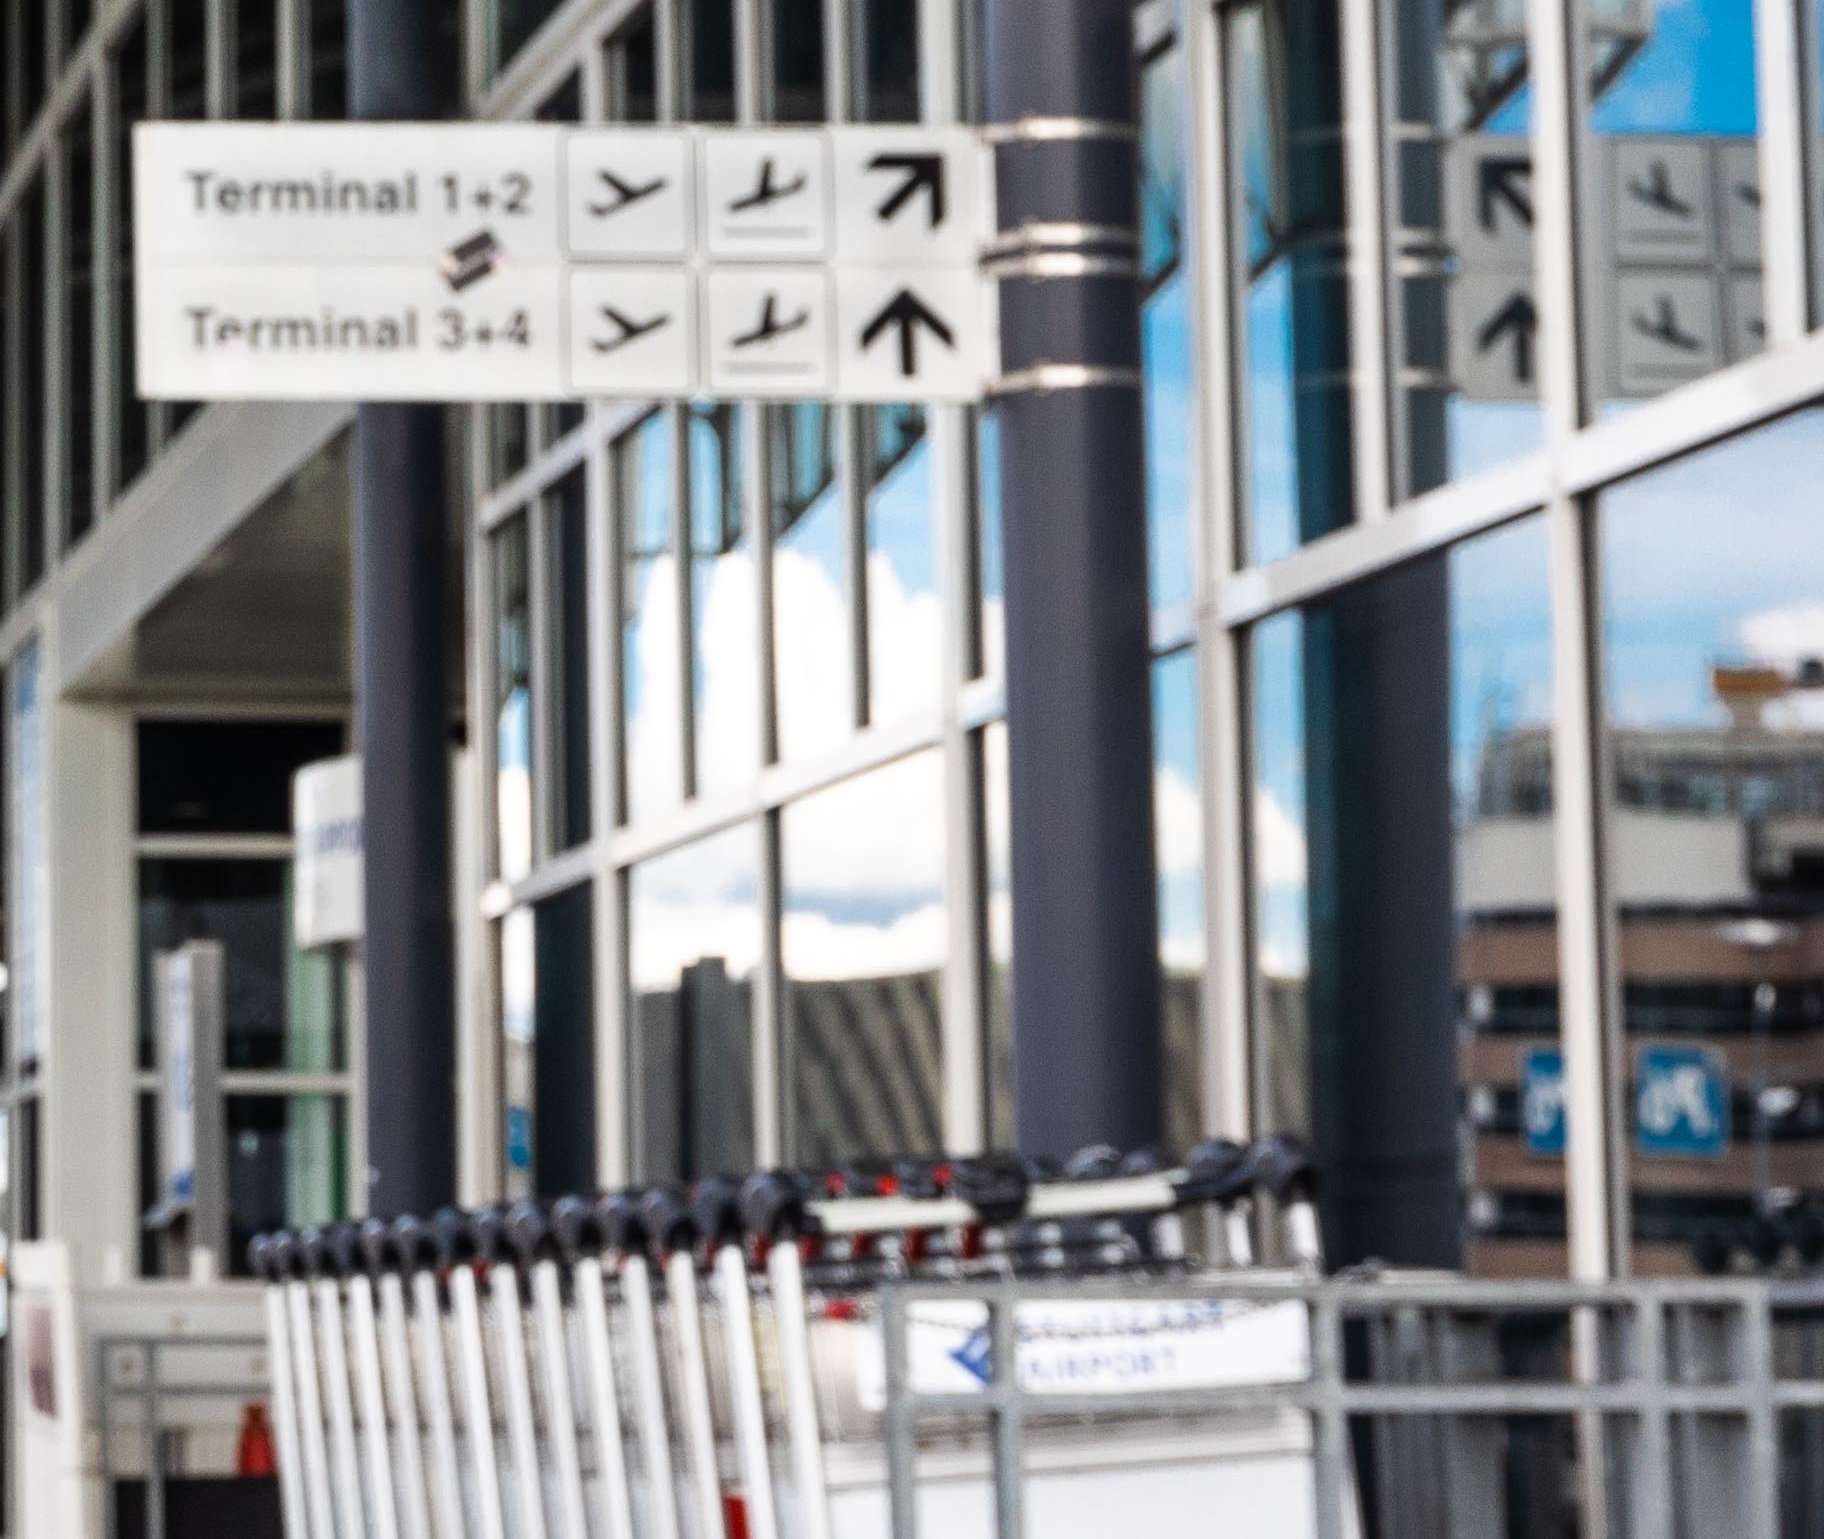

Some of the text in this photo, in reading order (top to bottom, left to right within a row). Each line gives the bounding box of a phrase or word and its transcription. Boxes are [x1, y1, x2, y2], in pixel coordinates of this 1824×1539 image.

[188, 171, 533, 216] Terminal 1+2
[188, 307, 532, 350] Terminal 3+4
